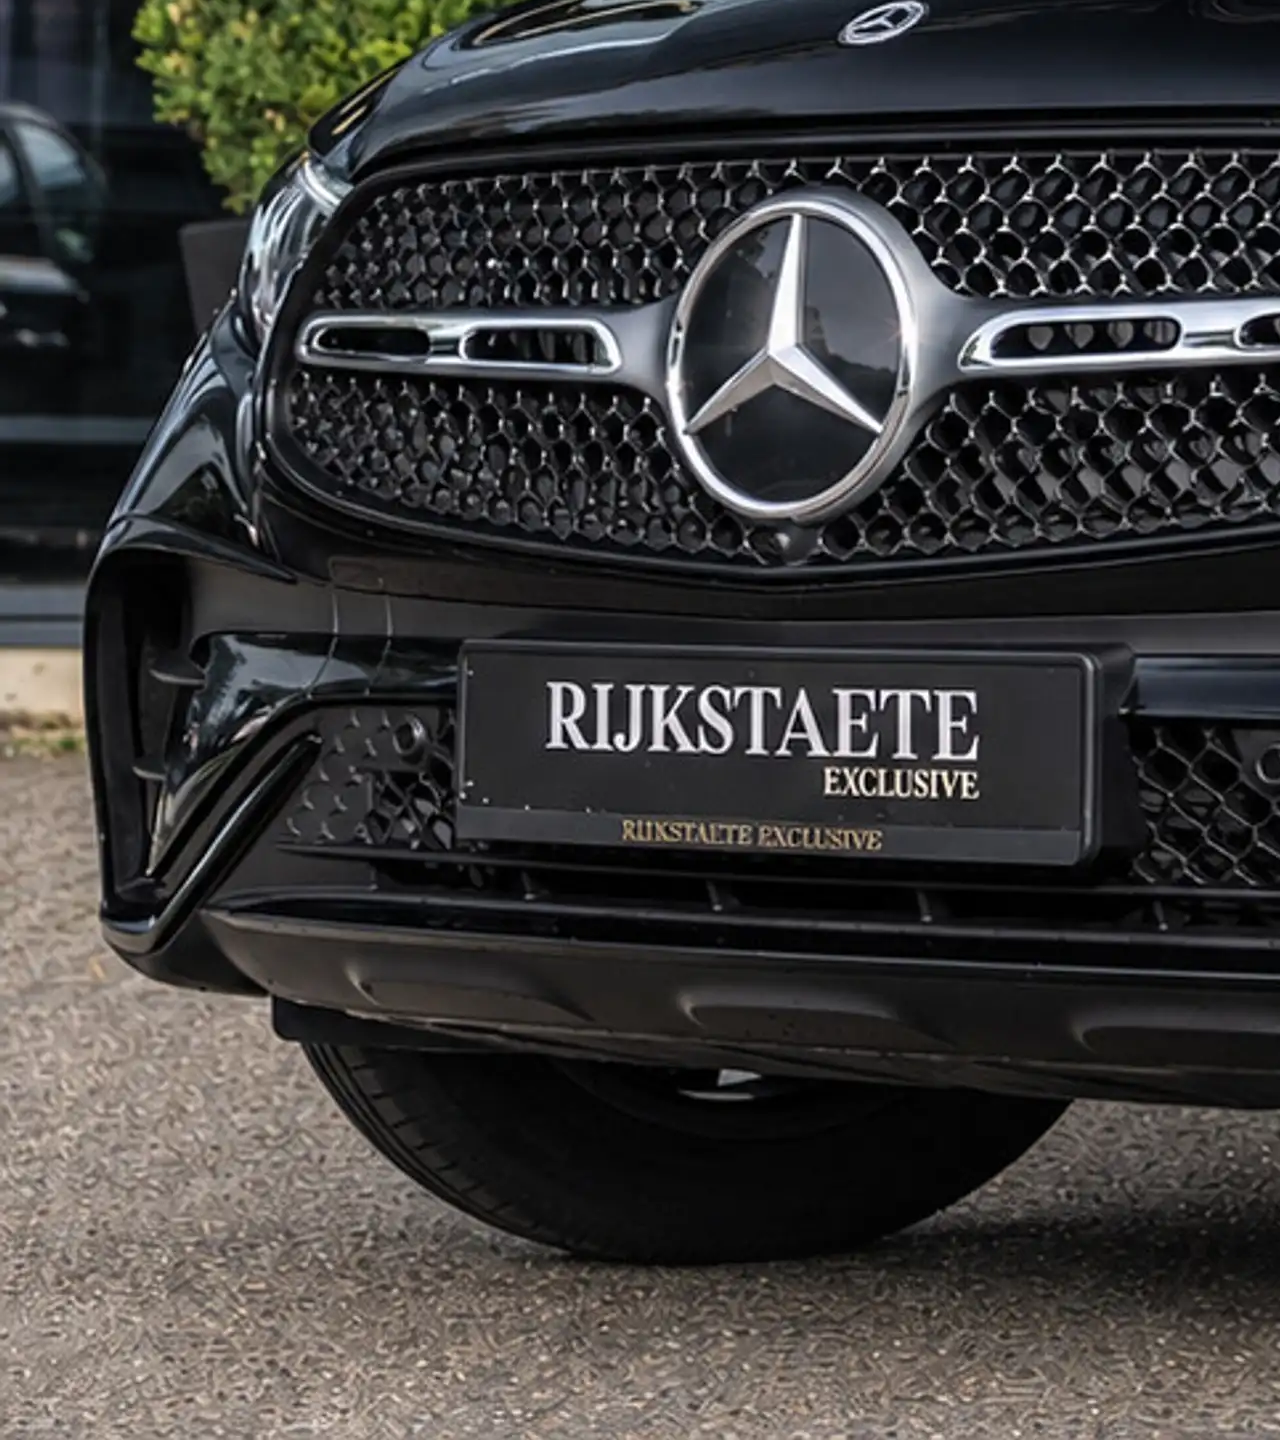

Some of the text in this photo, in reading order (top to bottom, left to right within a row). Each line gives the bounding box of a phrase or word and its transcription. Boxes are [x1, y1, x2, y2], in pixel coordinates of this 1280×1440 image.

[544, 681, 980, 762] RIJKSTAETE
[822, 766, 981, 801] EXCLUSIVE
[622, 818, 883, 853] RIJKSTAETE EXCLUSIVE
